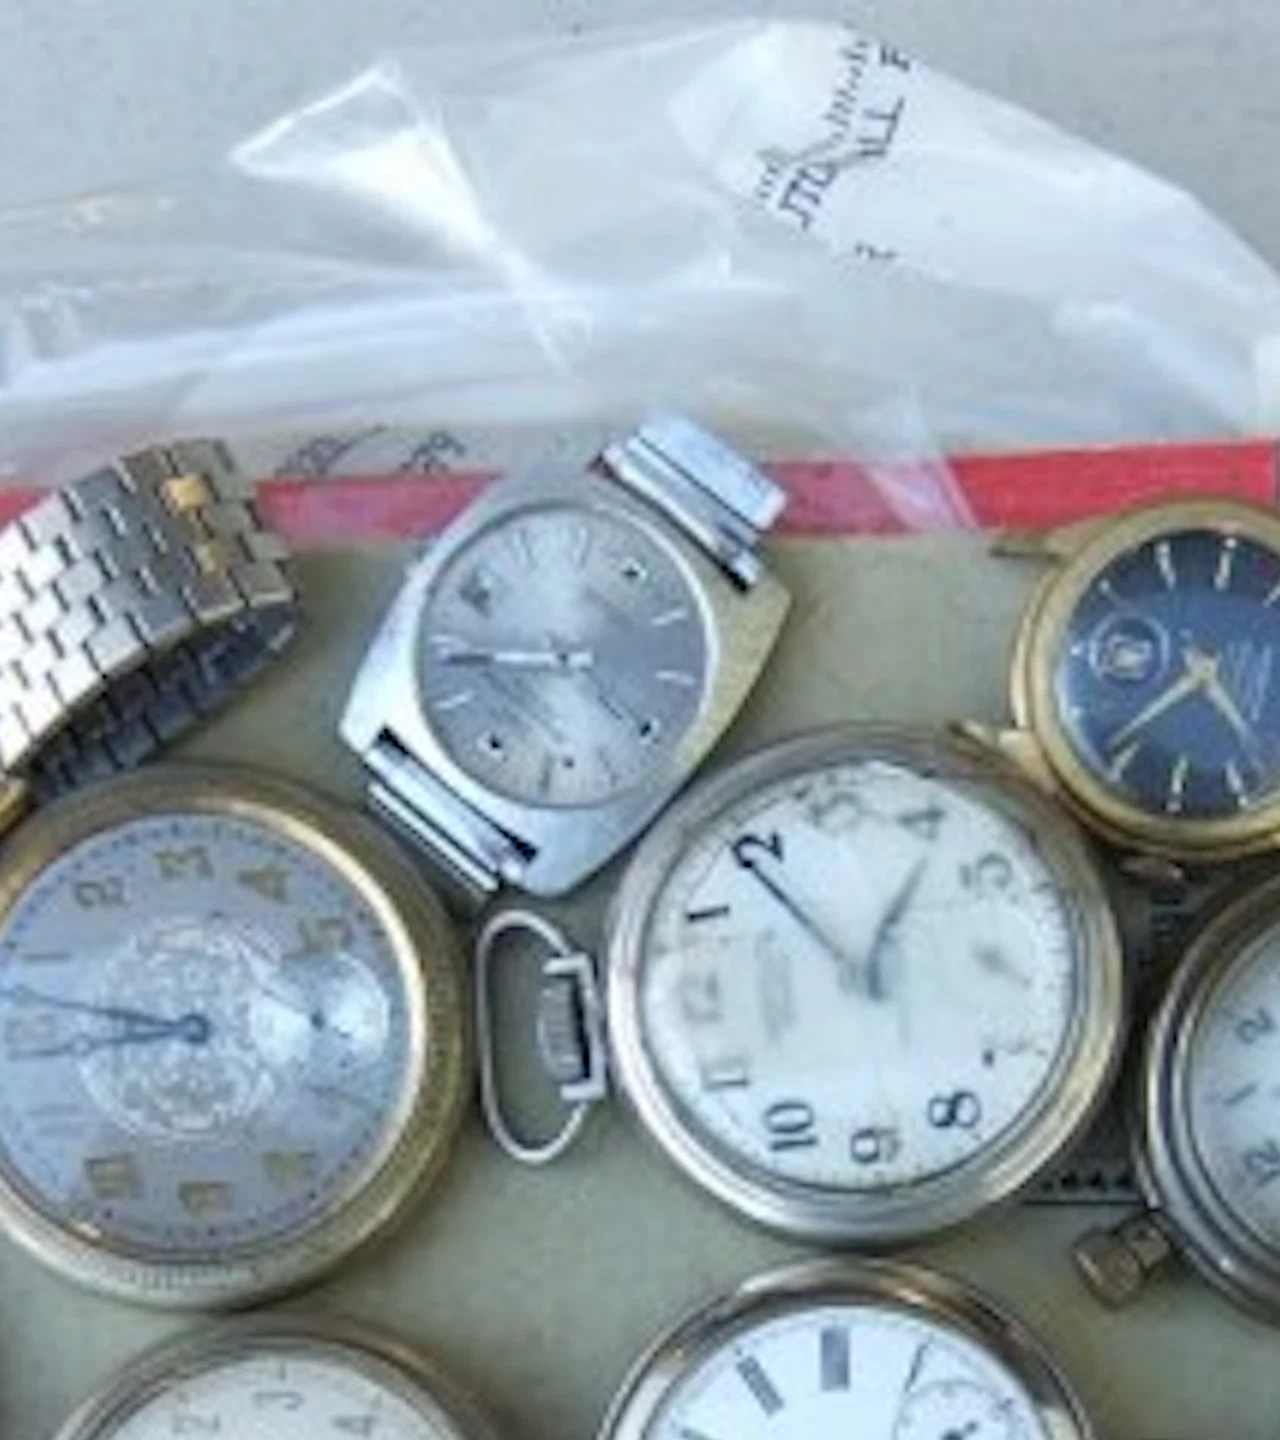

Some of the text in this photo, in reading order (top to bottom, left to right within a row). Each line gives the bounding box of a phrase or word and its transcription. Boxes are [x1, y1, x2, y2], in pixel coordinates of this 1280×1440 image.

[730, 830, 784, 868] 2
[687, 904, 730, 923] 1
[1234, 1008, 1274, 1044] 2
[762, 1100, 817, 1152] 10
[928, 1089, 982, 1128] 8
[849, 1126, 903, 1164] 9
